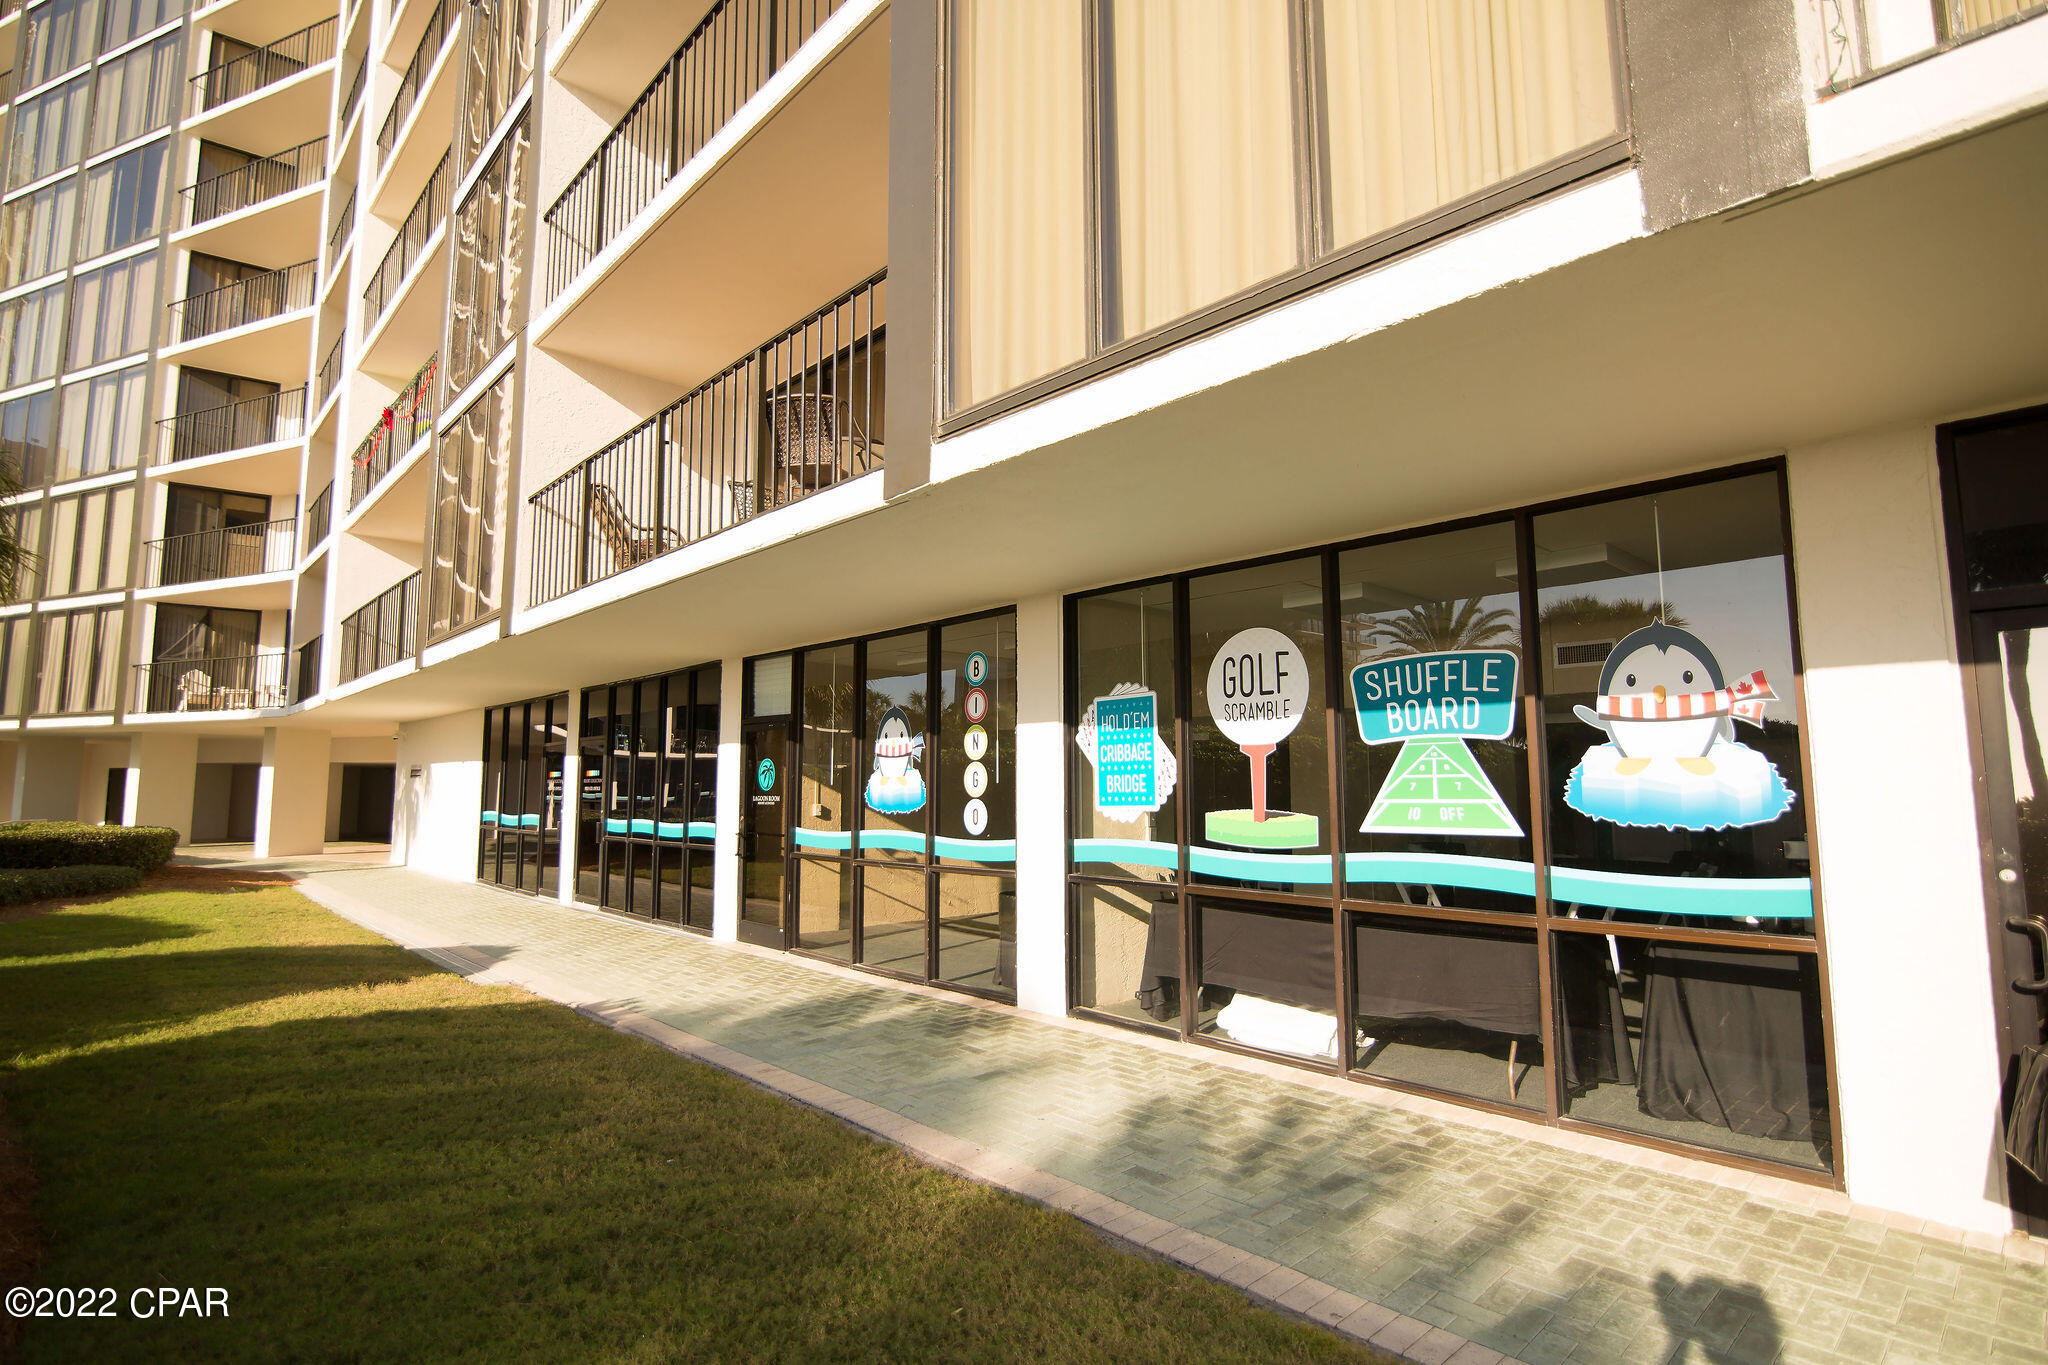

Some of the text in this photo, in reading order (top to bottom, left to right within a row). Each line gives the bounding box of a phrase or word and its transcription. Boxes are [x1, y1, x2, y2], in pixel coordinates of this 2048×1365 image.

[1222, 651, 1290, 698] GOLF
[1364, 659, 1502, 701] SHUFFLE
[1223, 698, 1291, 722] SCRAMBLE
[1386, 696, 1480, 734] BOARD
[1101, 711, 1151, 733] HOLD'EM
[1100, 742, 1152, 763] CRIBBAGE
[1106, 773, 1147, 793] BRIDGE
[1407, 806, 1464, 821] 10 OFF
